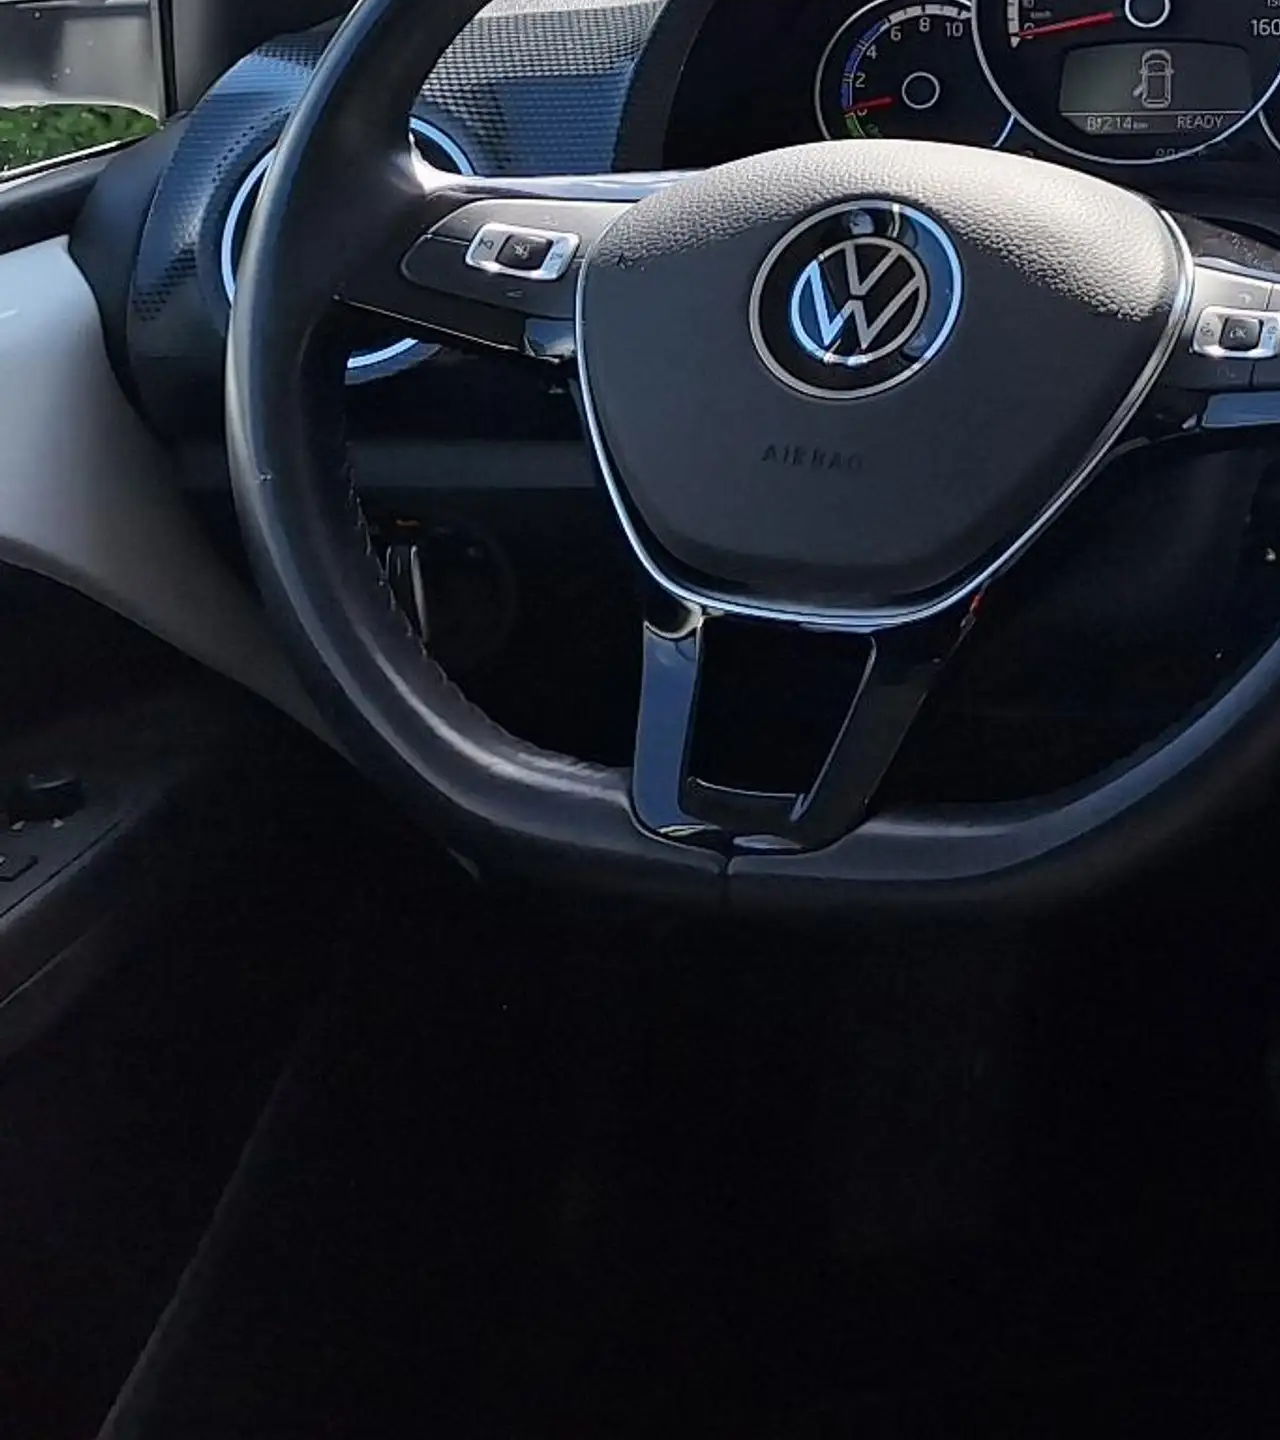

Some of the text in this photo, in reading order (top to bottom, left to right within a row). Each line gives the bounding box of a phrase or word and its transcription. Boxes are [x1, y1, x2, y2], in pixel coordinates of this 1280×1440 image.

[920, 17, 930, 32] 8
[945, 22, 964, 37] 10
[890, 25, 901, 40] 6
[866, 44, 877, 60] 4
[854, 72, 866, 88] 2
[1177, 115, 1224, 129] READY
[761, 444, 864, 471] AIRBAG
